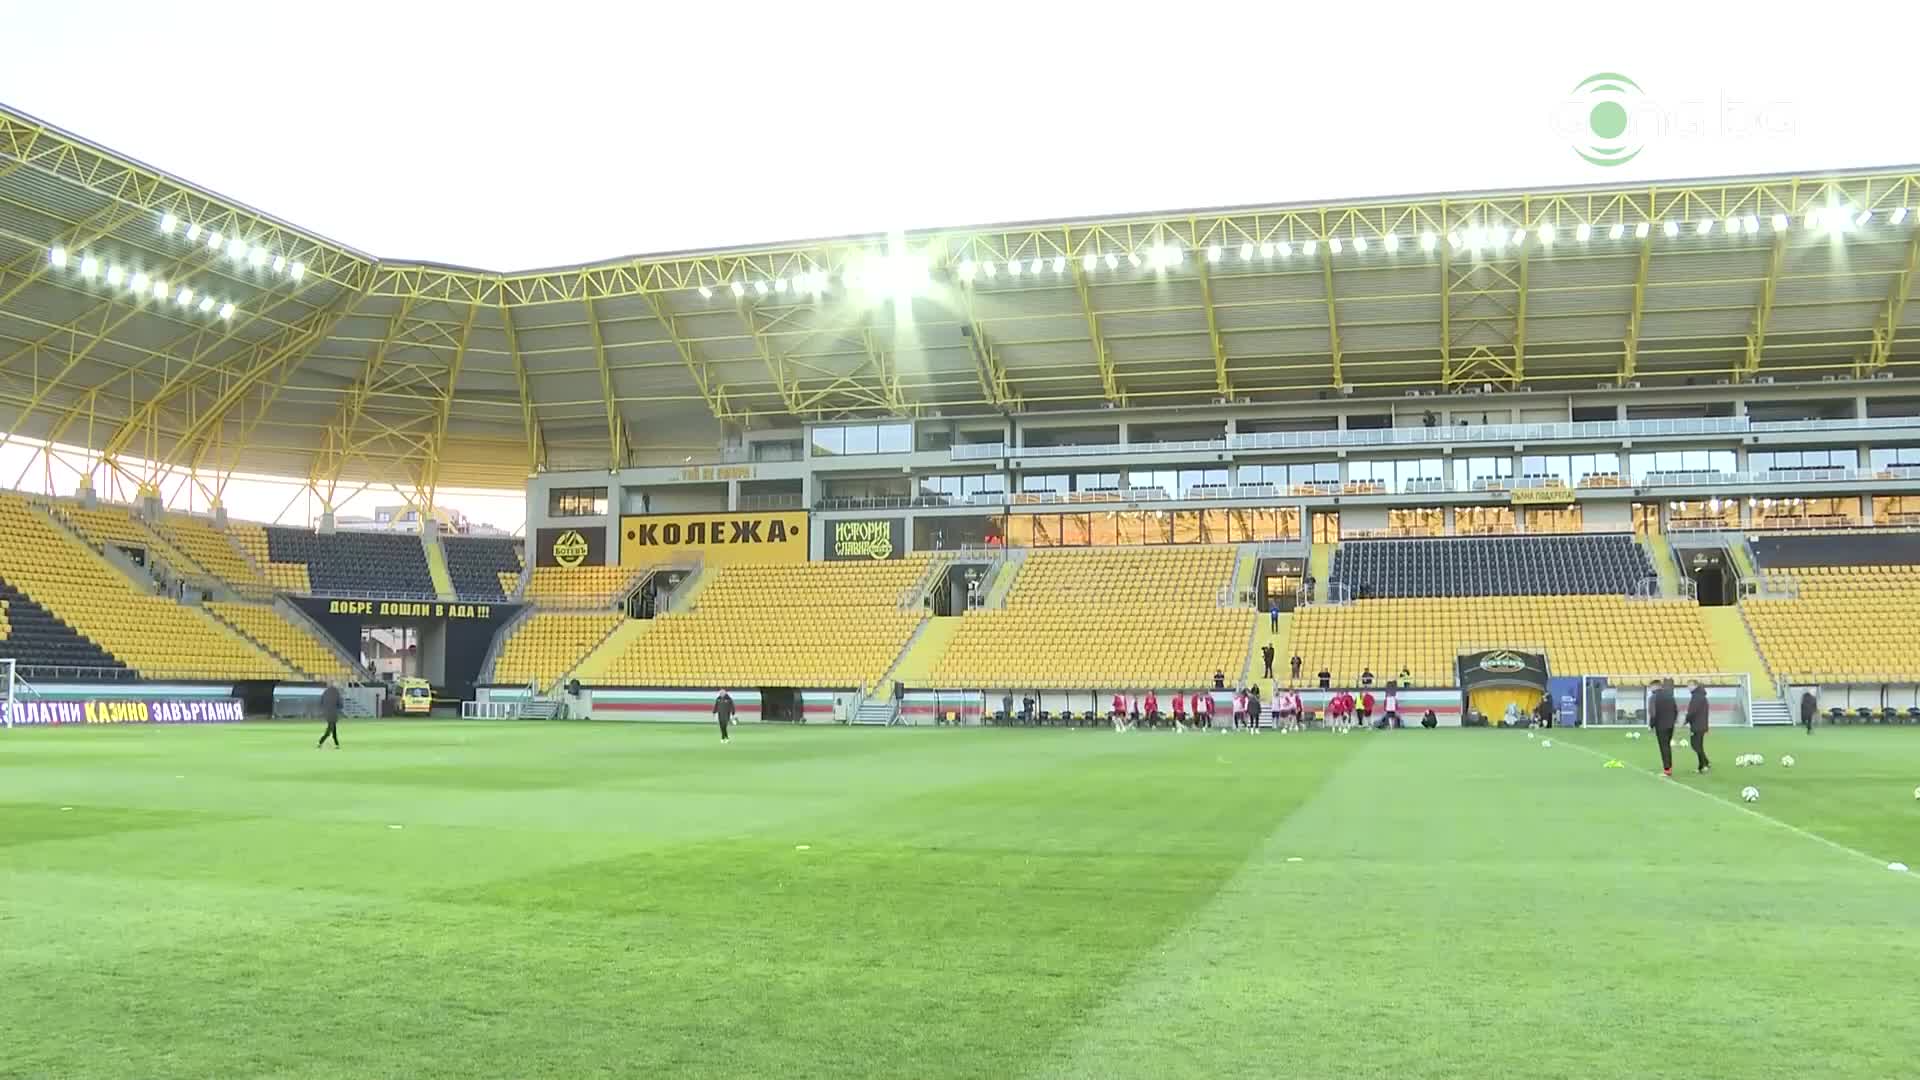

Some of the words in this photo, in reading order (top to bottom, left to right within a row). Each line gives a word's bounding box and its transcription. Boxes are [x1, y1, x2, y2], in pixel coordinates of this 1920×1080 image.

[639, 519, 787, 546] КОЛЕЖА
[835, 521, 890, 542] ИСТОРИЯ
[329, 601, 373, 614] ДОБРЕ
[380, 602, 430, 617] ДОШЛИ
[435, 605, 444, 617] В
[84, 700, 149, 723] КАЗИНО
[153, 701, 244, 721] ЗАВЪРТАНИЯ
